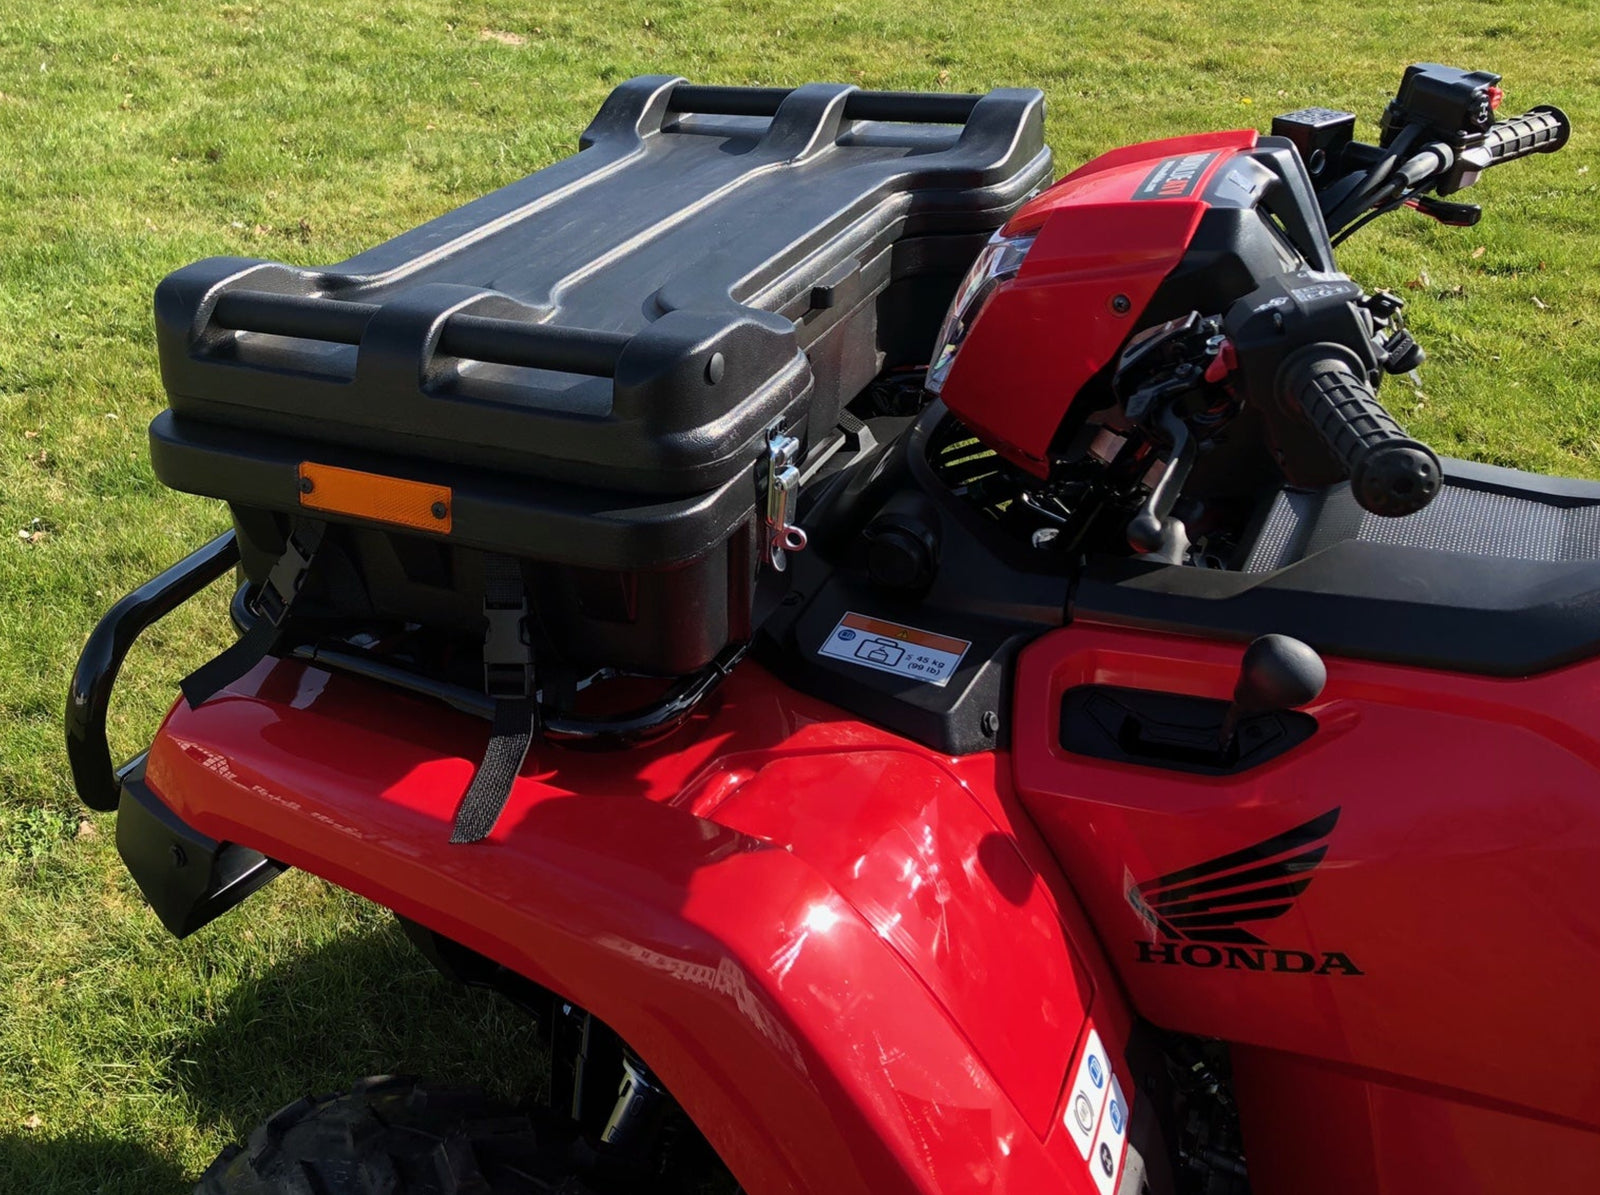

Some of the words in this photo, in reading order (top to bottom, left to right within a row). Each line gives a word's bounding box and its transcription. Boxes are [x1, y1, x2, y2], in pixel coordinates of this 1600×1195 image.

[907, 662, 924, 670] (99
[926, 666, 940, 675] lb)
[932, 660, 945, 668] kg
[1134, 941, 1365, 975] HONDA
